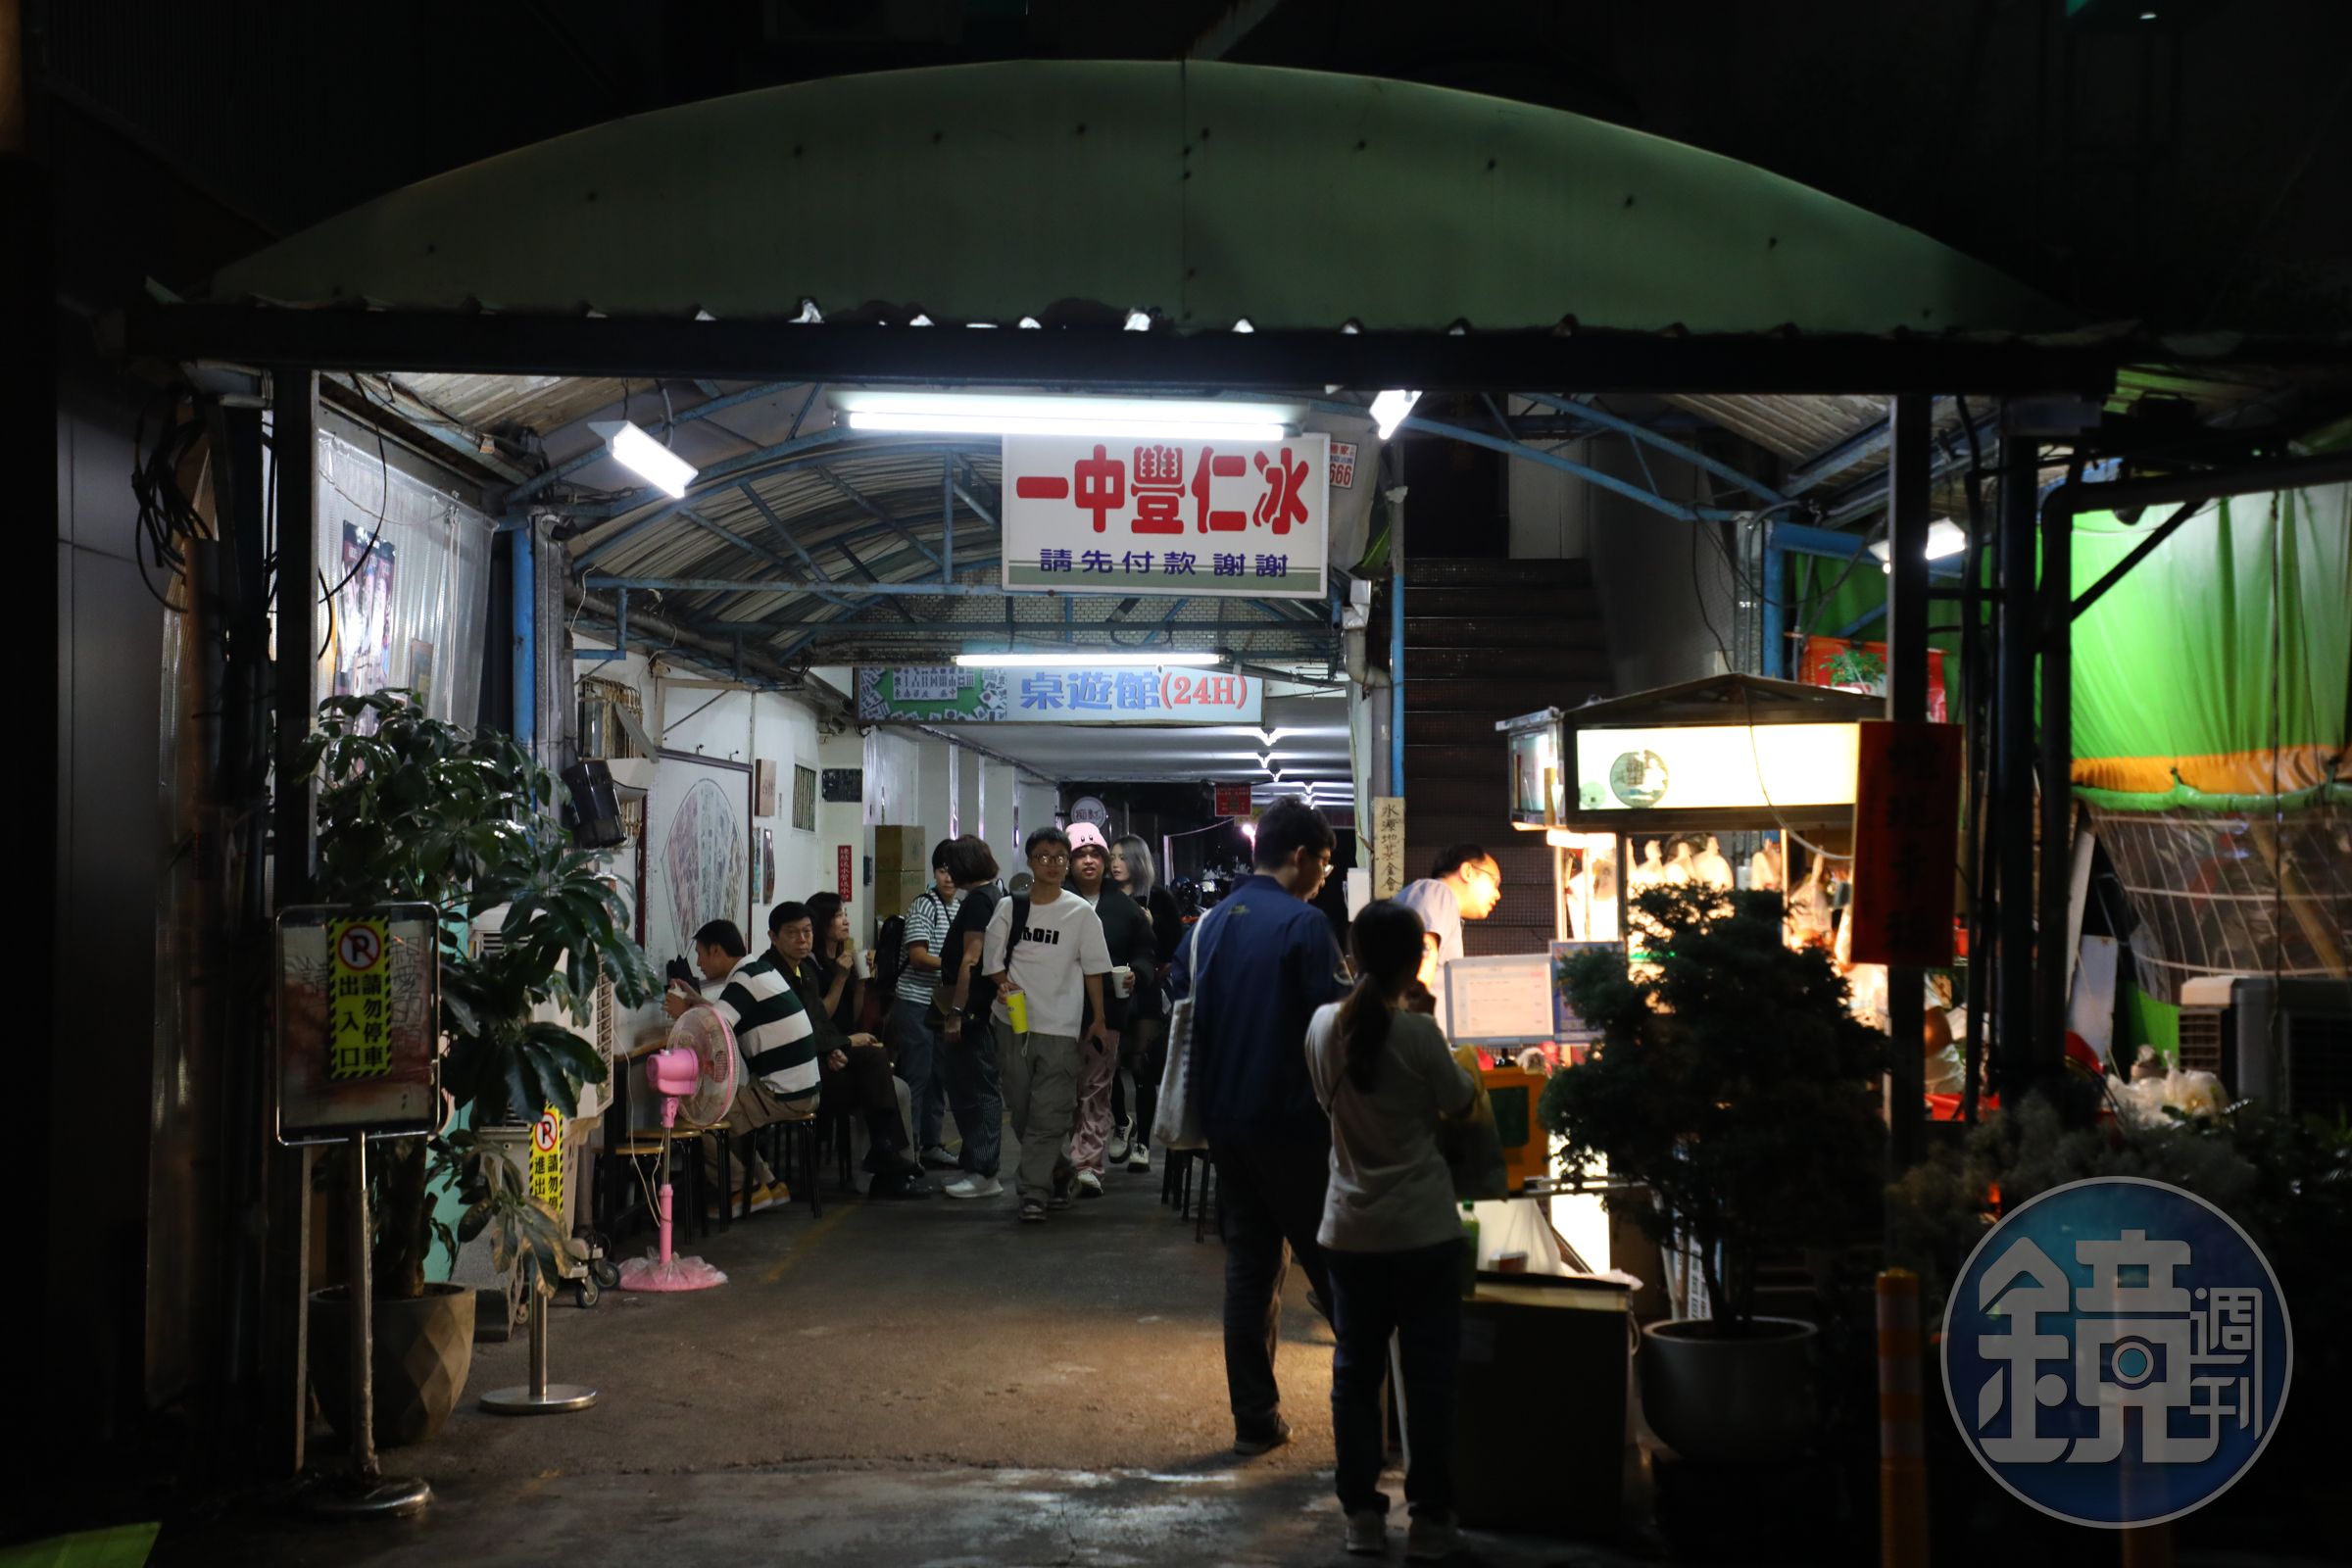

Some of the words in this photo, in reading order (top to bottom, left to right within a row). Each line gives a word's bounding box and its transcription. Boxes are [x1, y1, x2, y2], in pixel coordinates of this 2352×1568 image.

[1015, 444, 1309, 535] 一中豐仁冰
[1039, 549, 1197, 576] 請先付款
[1212, 553, 1289, 578] 謝謝
[338, 975, 360, 1067] 出入口
[362, 973, 383, 1067] 請勿停車
